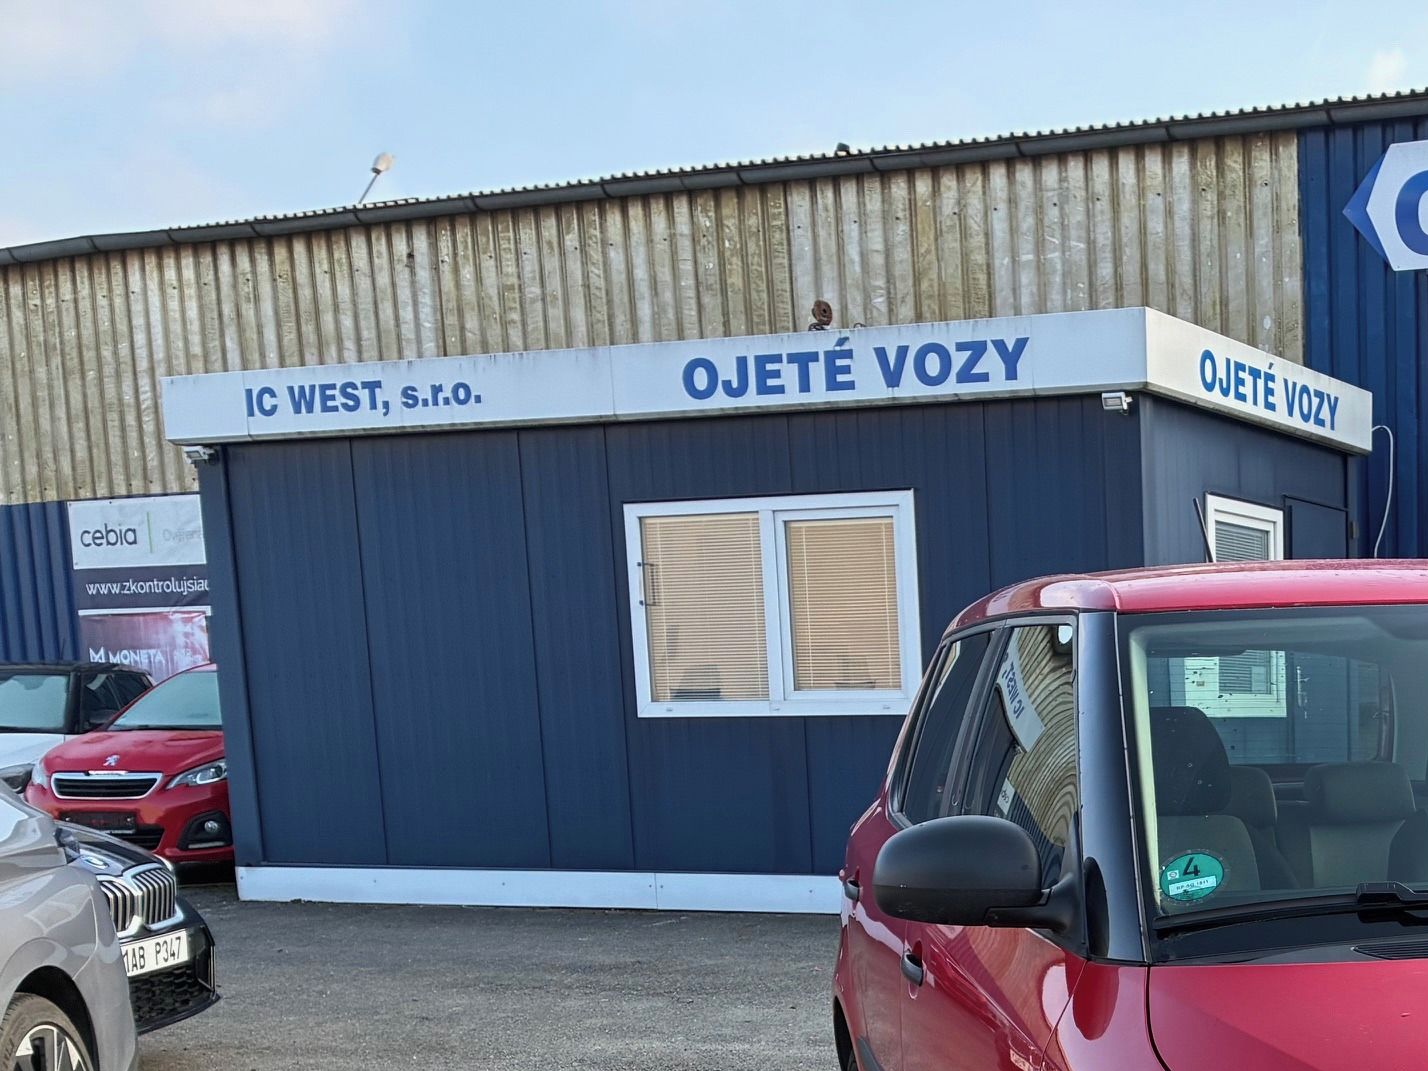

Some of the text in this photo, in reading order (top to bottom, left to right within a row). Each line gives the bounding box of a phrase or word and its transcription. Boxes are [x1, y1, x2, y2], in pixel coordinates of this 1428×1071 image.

[682, 336, 1031, 400] OJETÉ VOZY
[245, 380, 482, 418] IC WEST, s.r.o.
[1200, 349, 1339, 431] OJETÉ VOZY
[80, 523, 138, 548] cebia
[109, 648, 165, 664] MONETA
[1183, 857, 1201, 877] 4
[122, 936, 181, 973] 1AB P347
